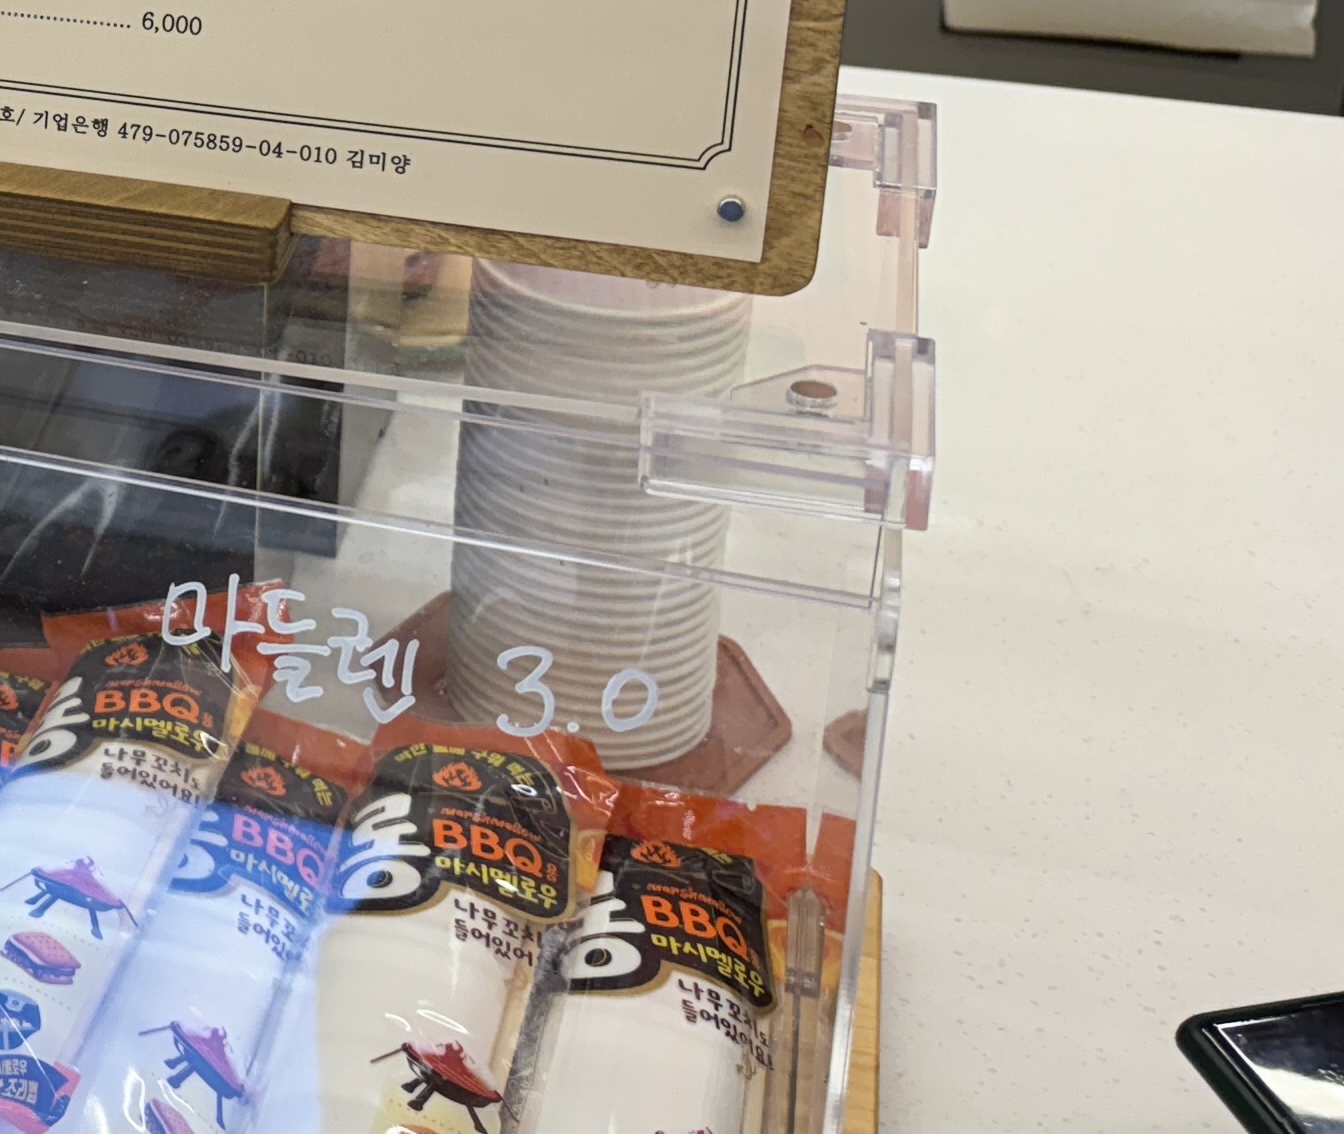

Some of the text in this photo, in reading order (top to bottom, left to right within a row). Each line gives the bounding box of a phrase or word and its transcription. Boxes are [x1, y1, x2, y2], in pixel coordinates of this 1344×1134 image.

[141, 11, 203, 36] 6,000
[32, 110, 109, 138] 기업은행
[118, 122, 337, 165] 479-075859-04-010
[346, 149, 412, 175] 김미양
[161, 572, 659, 738] 마들렌 3.0
[94, 689, 200, 723] BBQ
[233, 813, 330, 894] BBQ
[432, 819, 543, 878] BBQ
[641, 894, 750, 962] BBQ
[651, 933, 765, 998] 마시멜로우
